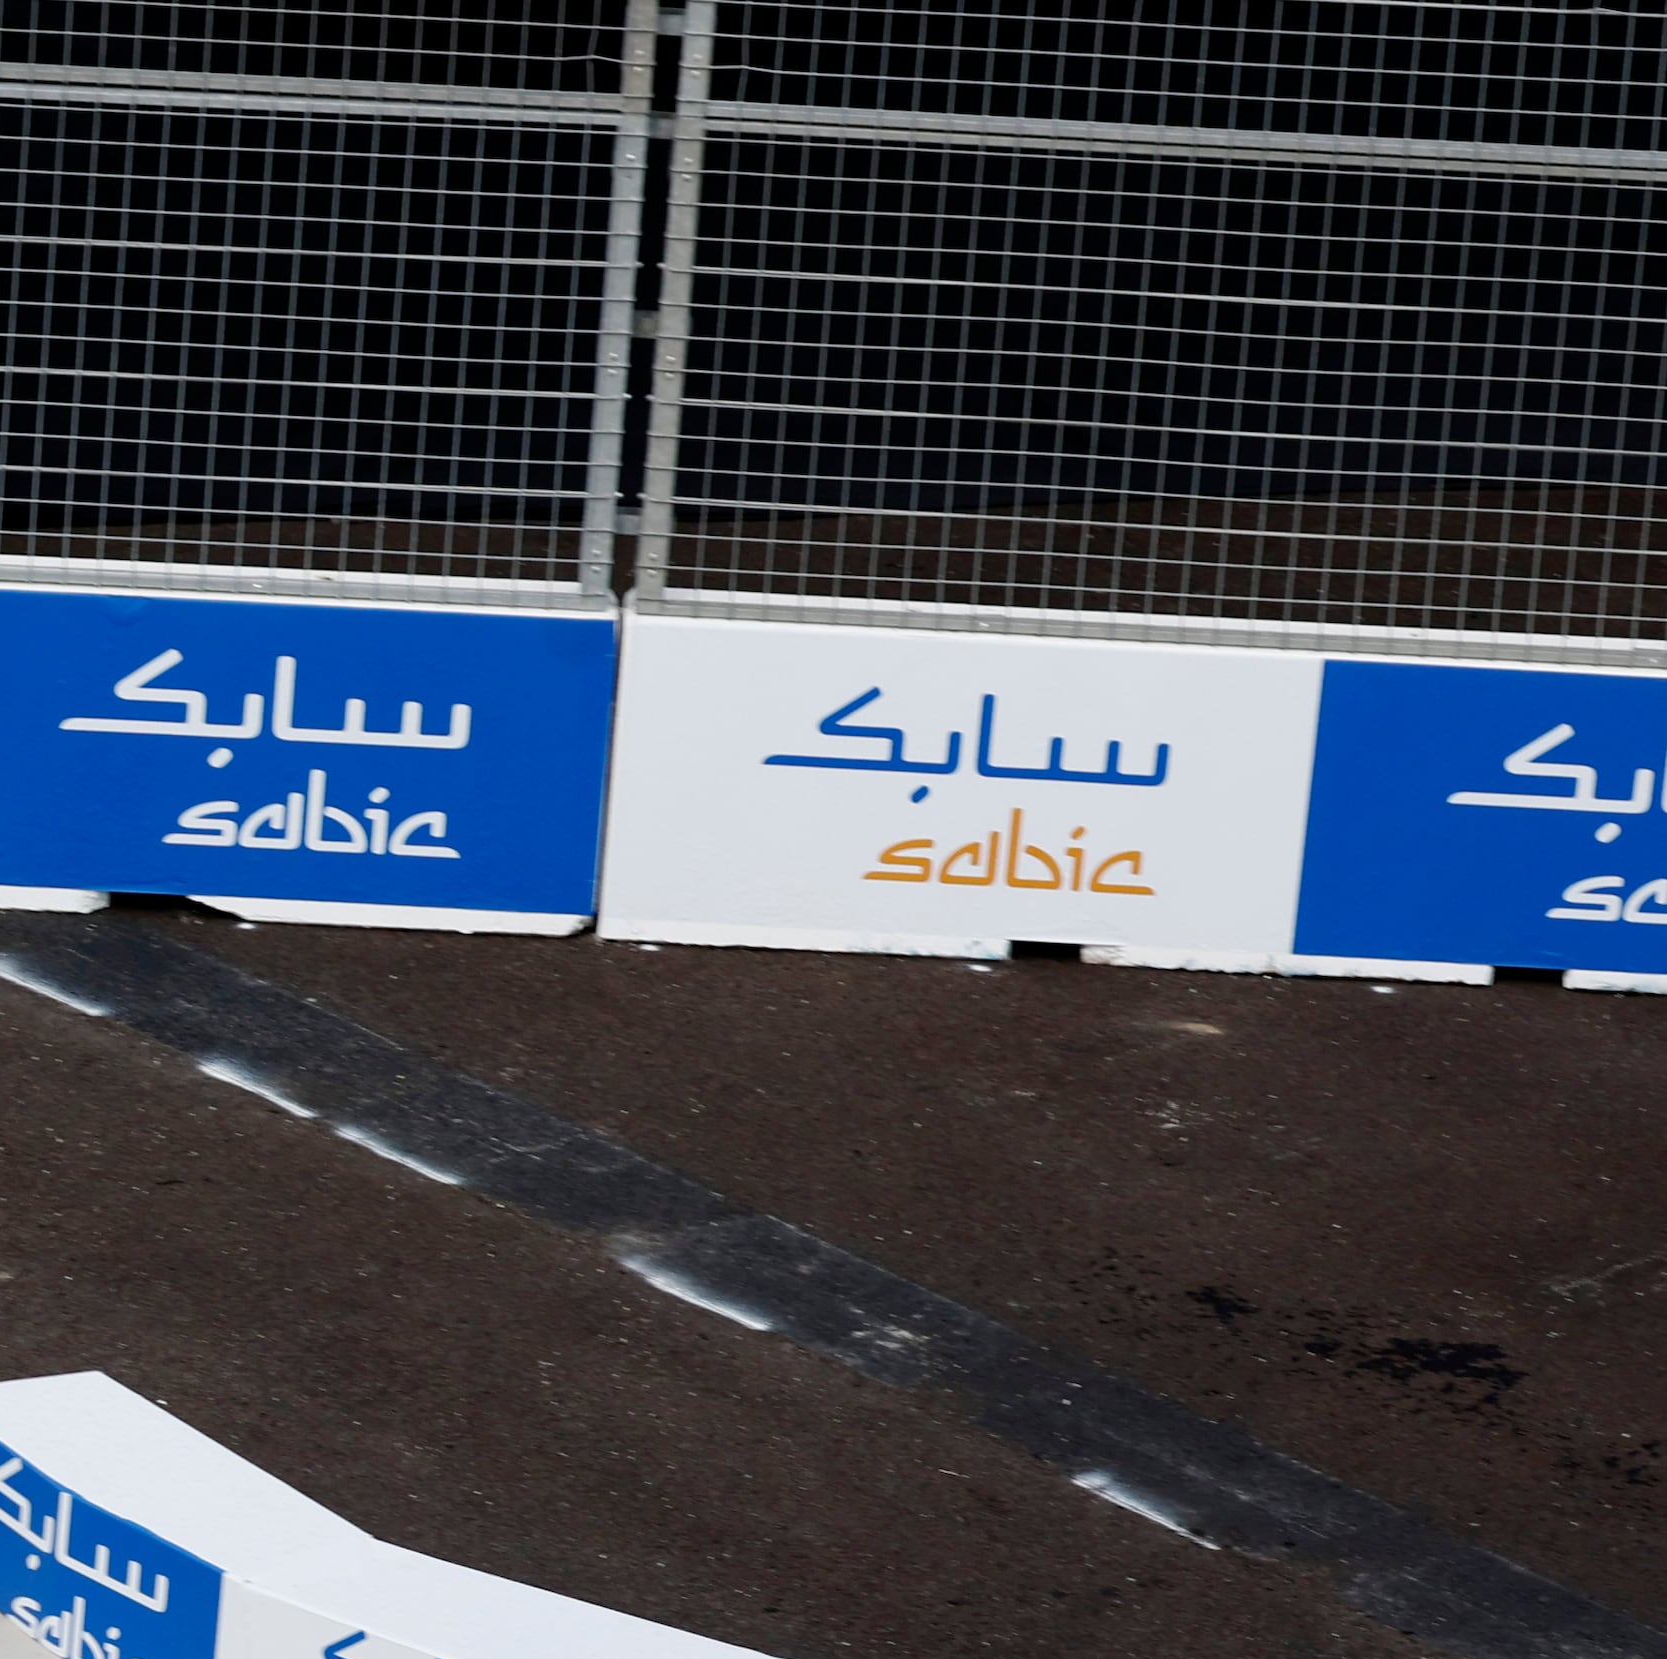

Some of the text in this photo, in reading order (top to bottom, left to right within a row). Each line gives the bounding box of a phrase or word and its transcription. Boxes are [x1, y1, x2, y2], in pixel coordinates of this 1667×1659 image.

[60, 650, 470, 768] سابك
[763, 687, 1170, 803] سابك
[163, 769, 460, 859] sabic
[863, 808, 1154, 896] sabic
